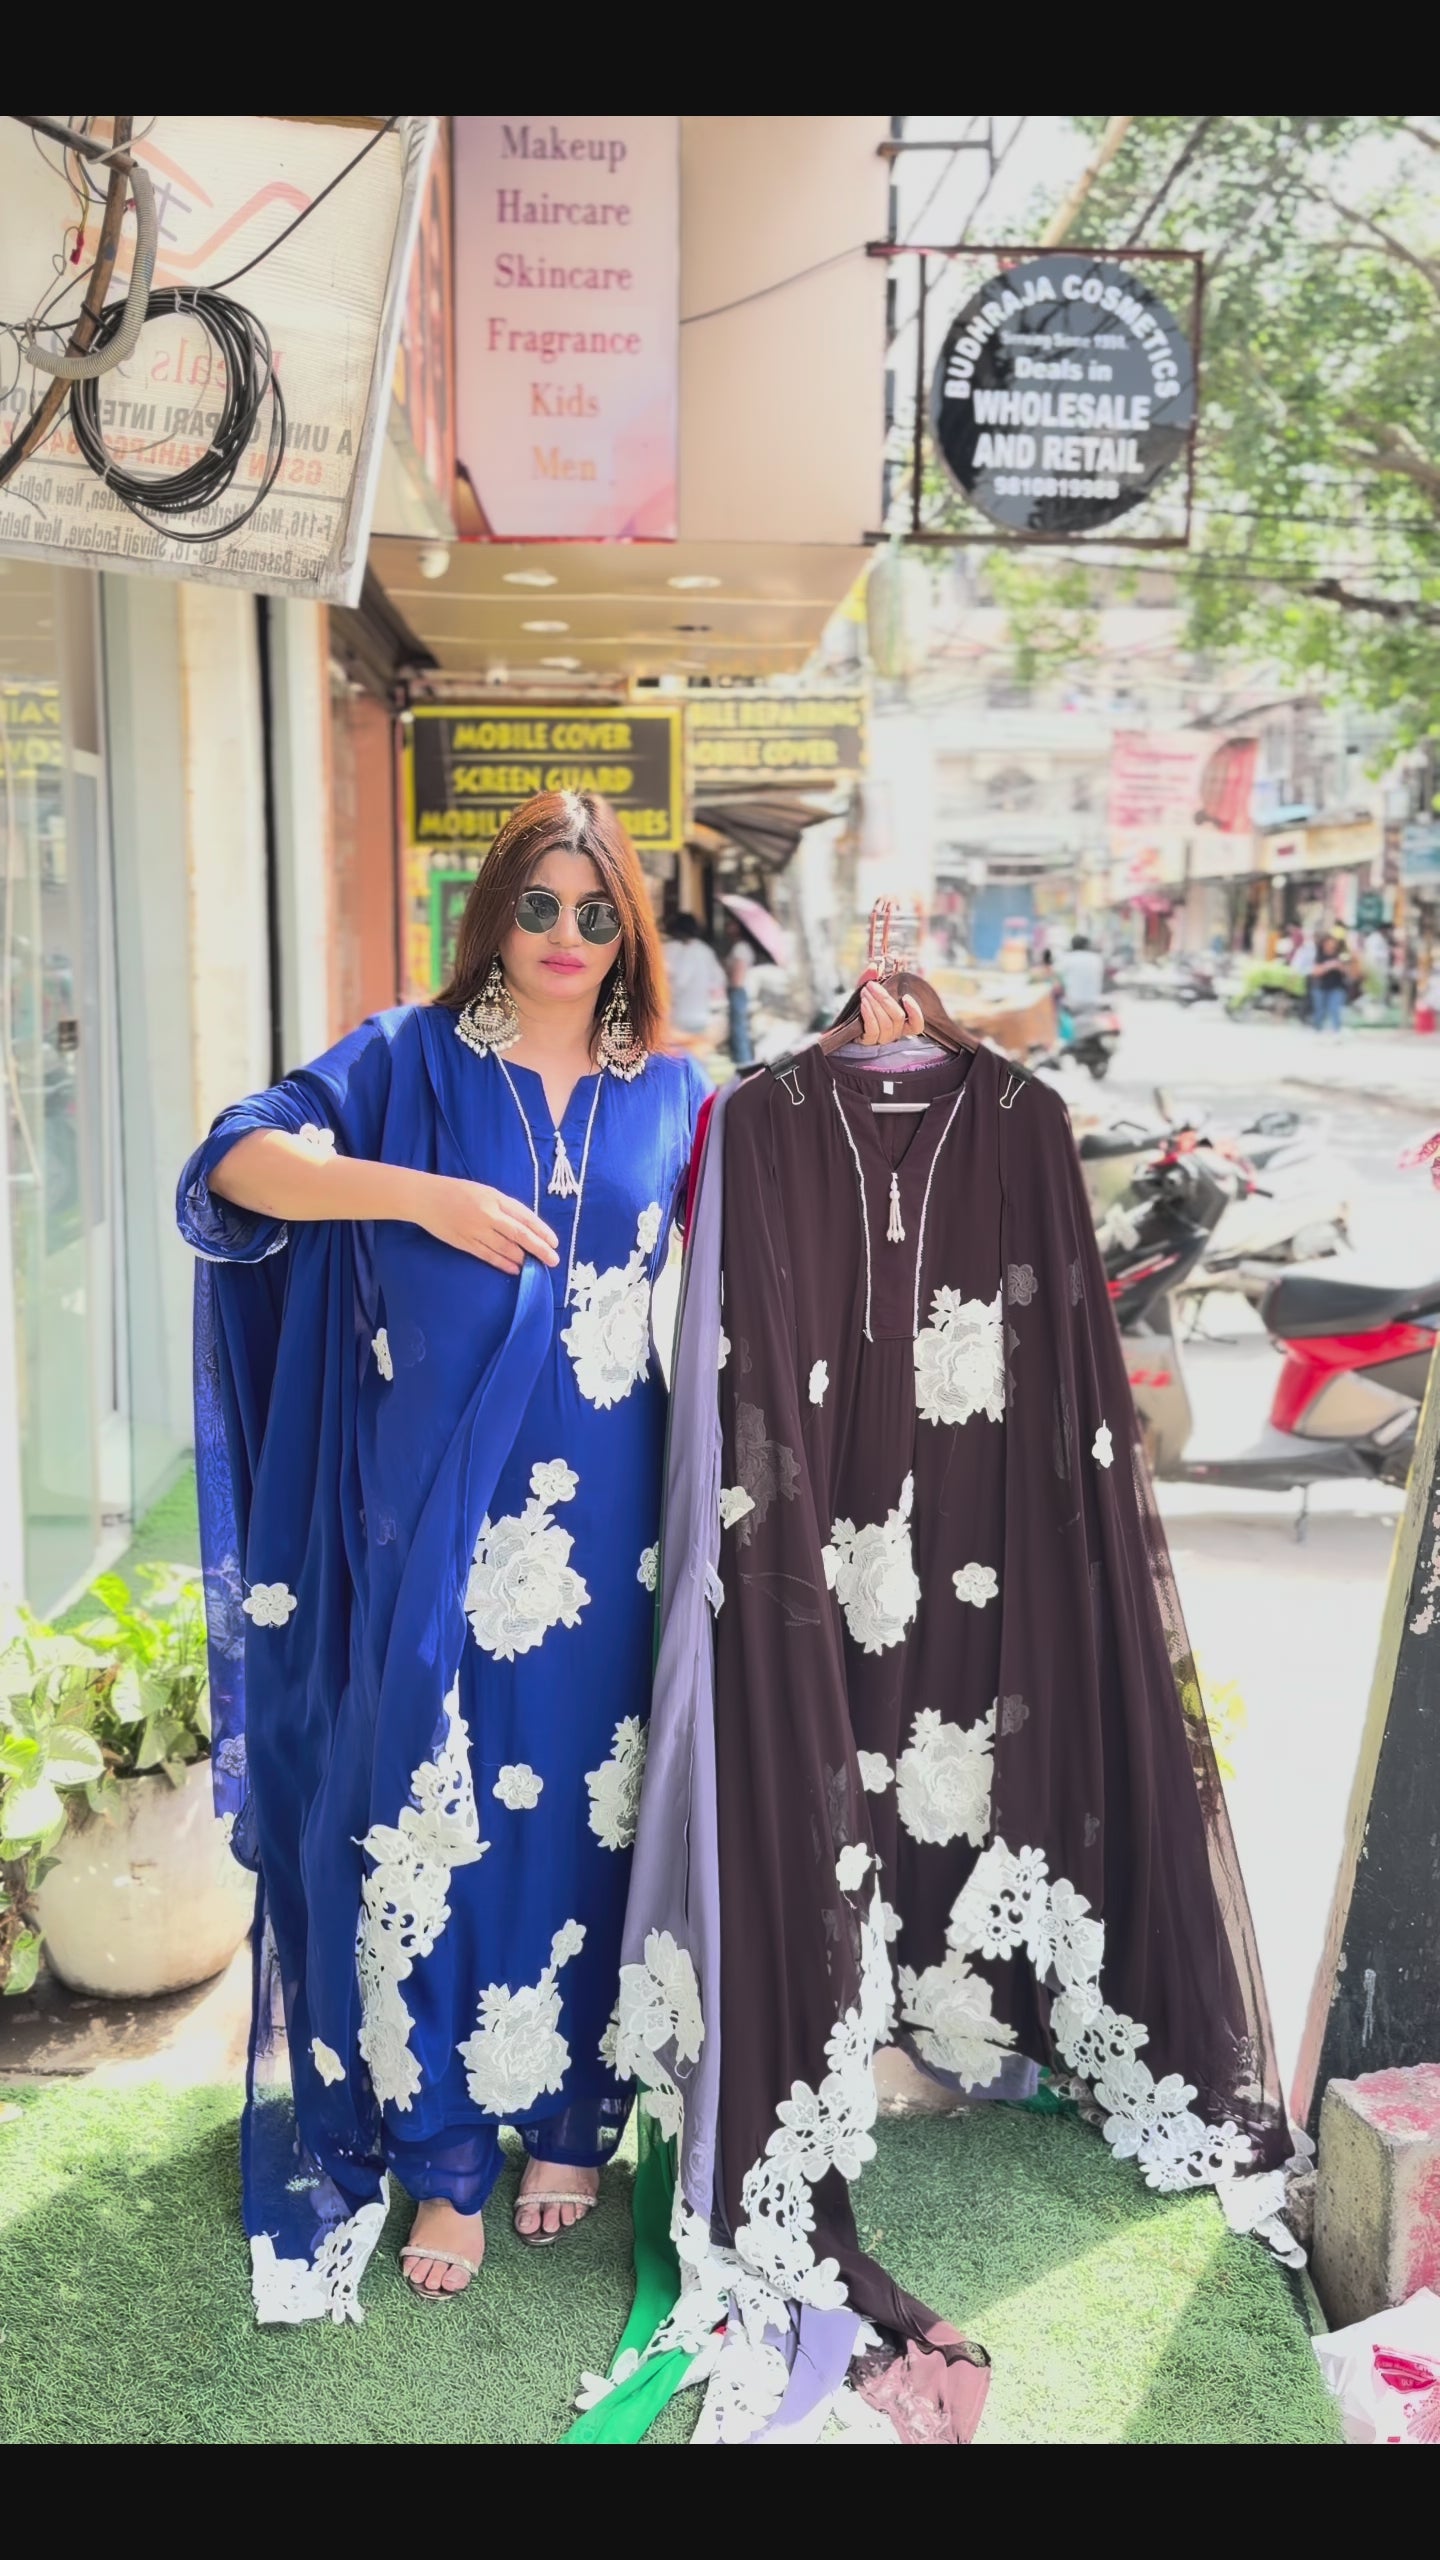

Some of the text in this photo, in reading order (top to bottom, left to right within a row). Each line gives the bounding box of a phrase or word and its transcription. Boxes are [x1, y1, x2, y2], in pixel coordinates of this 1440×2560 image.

[501, 124, 627, 173] Makeup
[496, 188, 631, 226] Haircare
[494, 253, 633, 290] Skincare
[487, 317, 640, 363] Fragrance
[945, 275, 1181, 400] BUDHRAJA COSMETICS
[1014, 357, 1112, 382] Deals in
[530, 382, 599, 418] Kids
[973, 389, 1151, 431] WHOLESALE
[532, 446, 598, 481] Men
[972, 433, 1145, 474] AND RETAIL
[453, 723, 633, 750] MOBILE COVER
[452, 766, 634, 793] SCREEN GUARD
